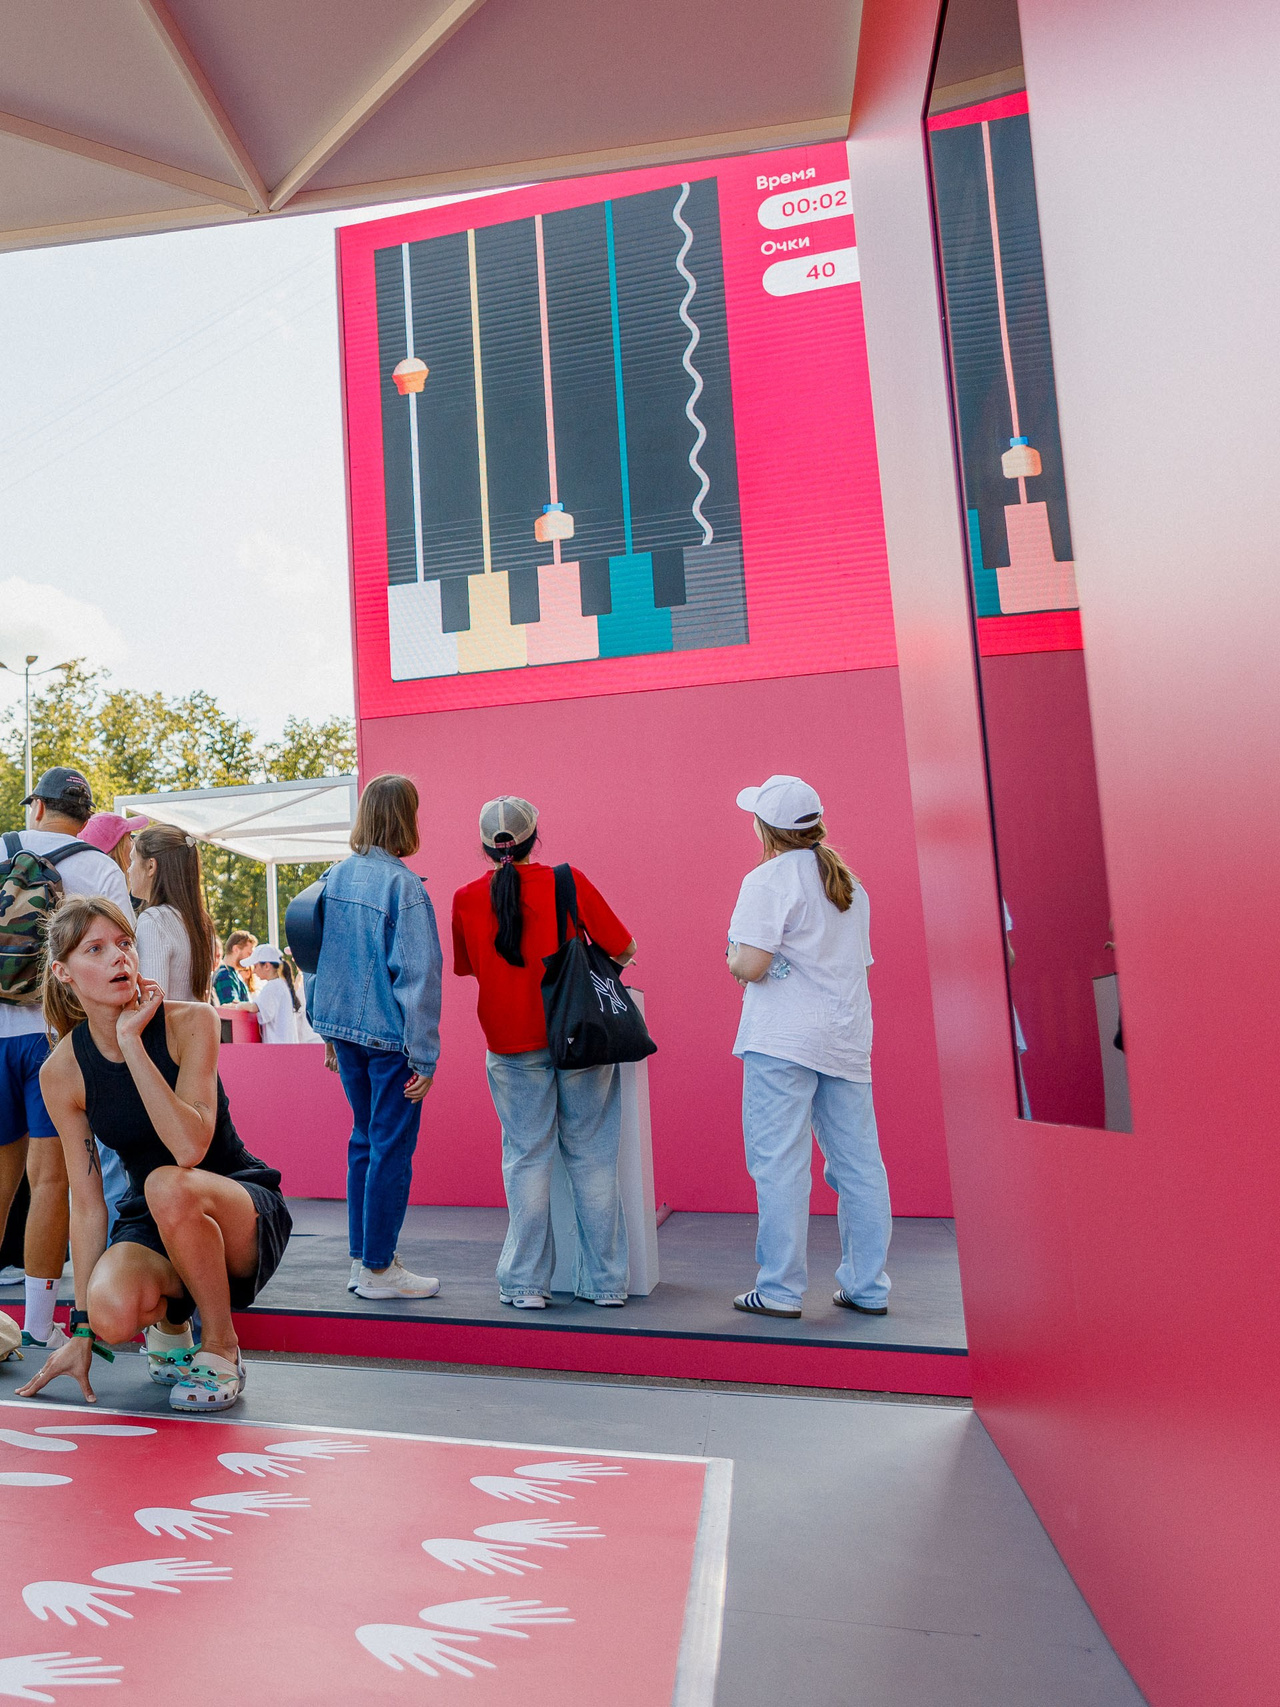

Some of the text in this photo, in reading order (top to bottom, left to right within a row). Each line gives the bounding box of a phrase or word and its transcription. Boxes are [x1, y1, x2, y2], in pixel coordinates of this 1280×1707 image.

[756, 167, 816, 191] Время
[782, 190, 847, 217] 00:02
[760, 236, 810, 255] Очки
[806, 262, 836, 280] 40
[589, 970, 628, 1014] NY
